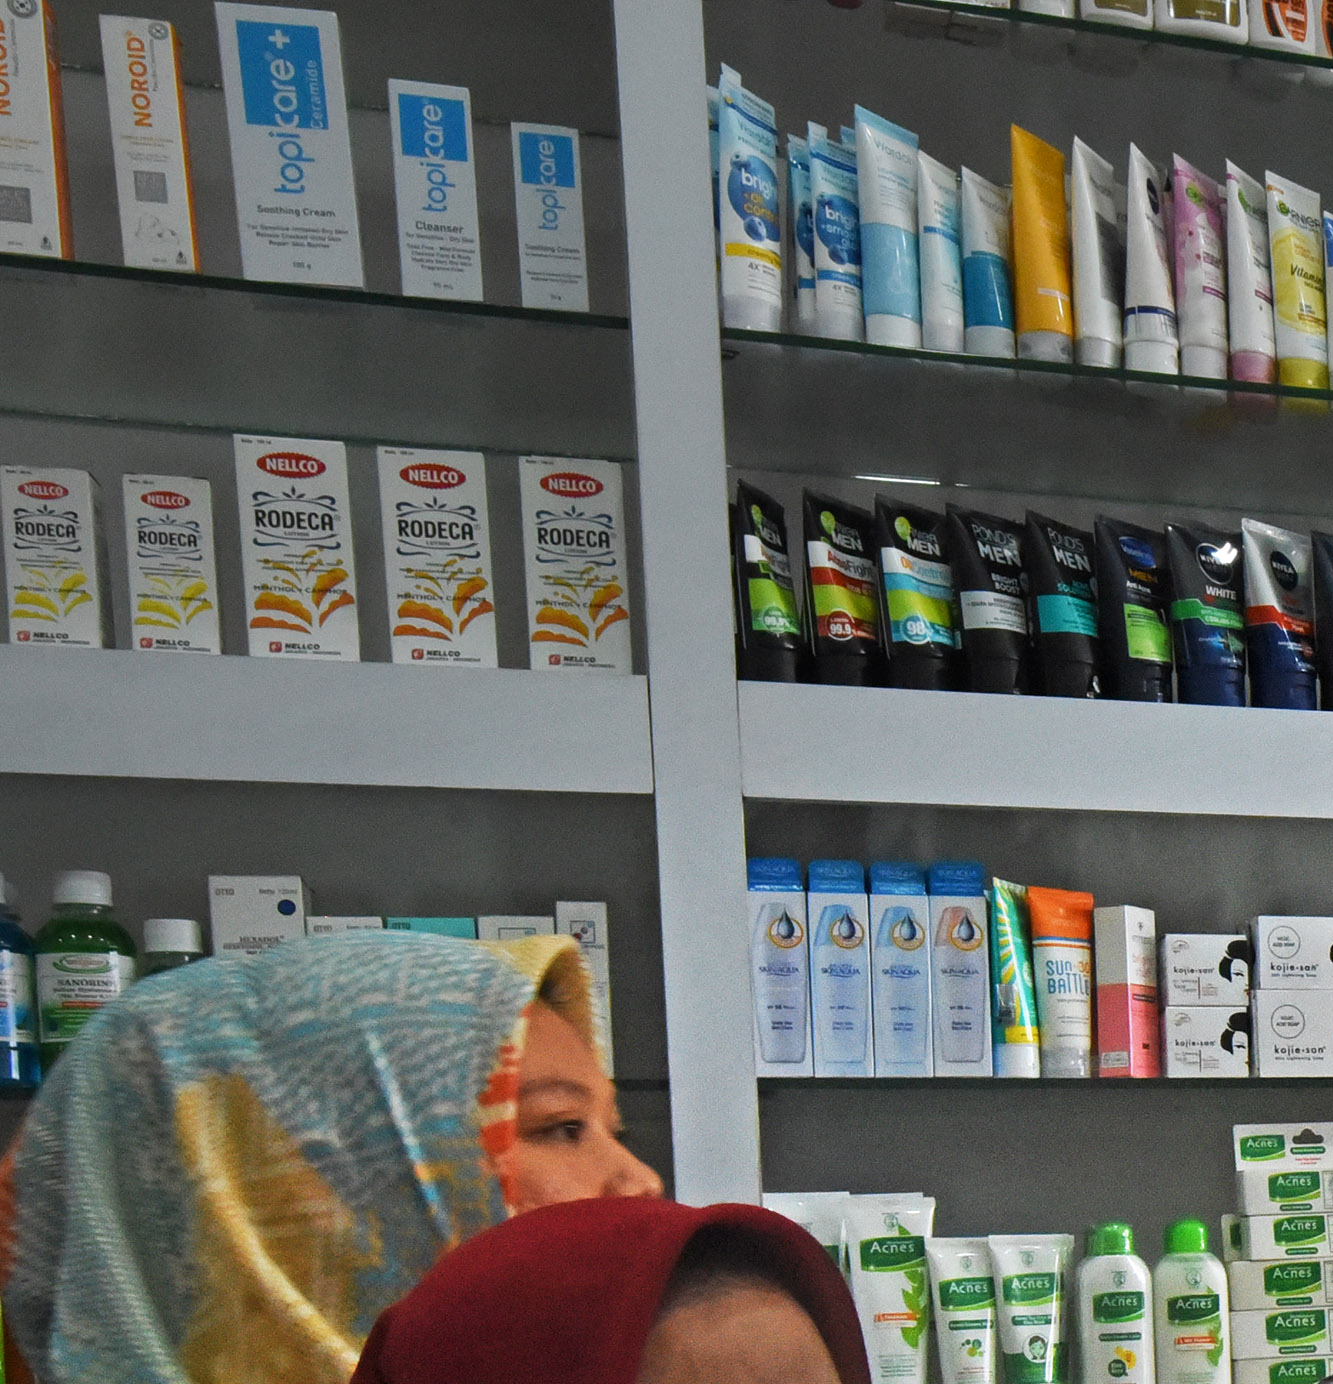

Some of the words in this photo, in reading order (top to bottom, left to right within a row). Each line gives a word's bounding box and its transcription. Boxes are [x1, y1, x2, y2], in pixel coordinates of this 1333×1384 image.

[126, 36, 153, 128] NOROID
[310, 59, 325, 130] Ceramide
[270, 57, 315, 194] topicare
[420, 104, 450, 213] topicare
[536, 138, 562, 232] topicare
[257, 204, 300, 217] Soothing
[302, 206, 336, 218] Cream
[415, 220, 464, 235] Cleanser
[264, 457, 319, 473] NELLCO
[407, 468, 459, 487] NELLCO
[547, 478, 597, 495] NELLCO
[24, 484, 64, 498] NELLCO
[146, 494, 186, 508] NELLCO
[14, 520, 78, 540] RODECA
[254, 508, 336, 532] RODECA
[398, 518, 475, 541] RODECA
[138, 529, 198, 549] RODECA
[537, 524, 611, 550] RODECA
[832, 530, 863, 552] MEN
[907, 537, 940, 557] MEN
[978, 540, 1022, 568] MEN
[1053, 543, 1091, 572] MEN
[1271, 560, 1297, 580] NIVEA
[1205, 584, 1237, 601] WHITE
[1246, 1136, 1279, 1152] Acnes
[1277, 1174, 1312, 1190] Acnes
[1282, 1219, 1317, 1234] Acnes
[871, 1238, 915, 1256] Acnes
[1012, 1276, 1050, 1292] Acnes
